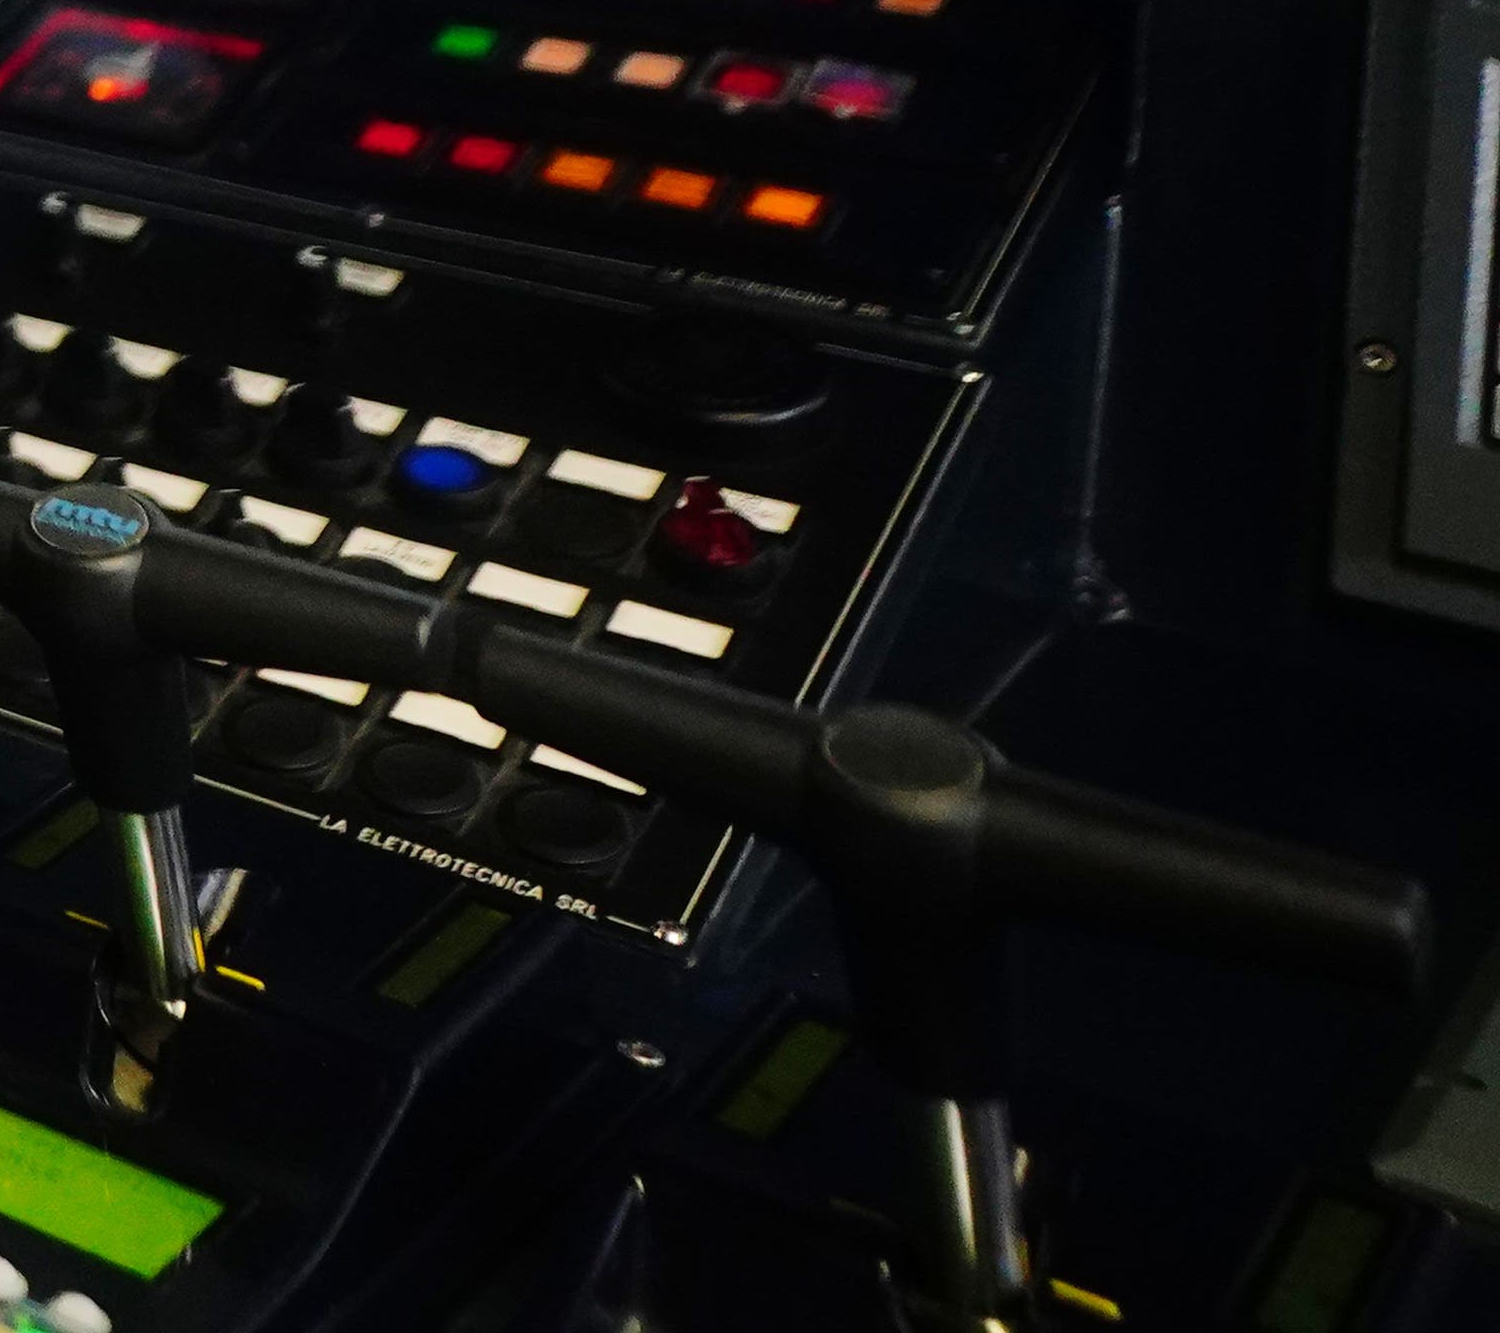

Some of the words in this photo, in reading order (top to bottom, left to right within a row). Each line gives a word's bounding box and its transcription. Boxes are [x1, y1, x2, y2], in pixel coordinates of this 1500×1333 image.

[319, 814, 348, 834] LA
[356, 827, 544, 902] ELETTROTECNICA
[555, 893, 599, 921] SRL
